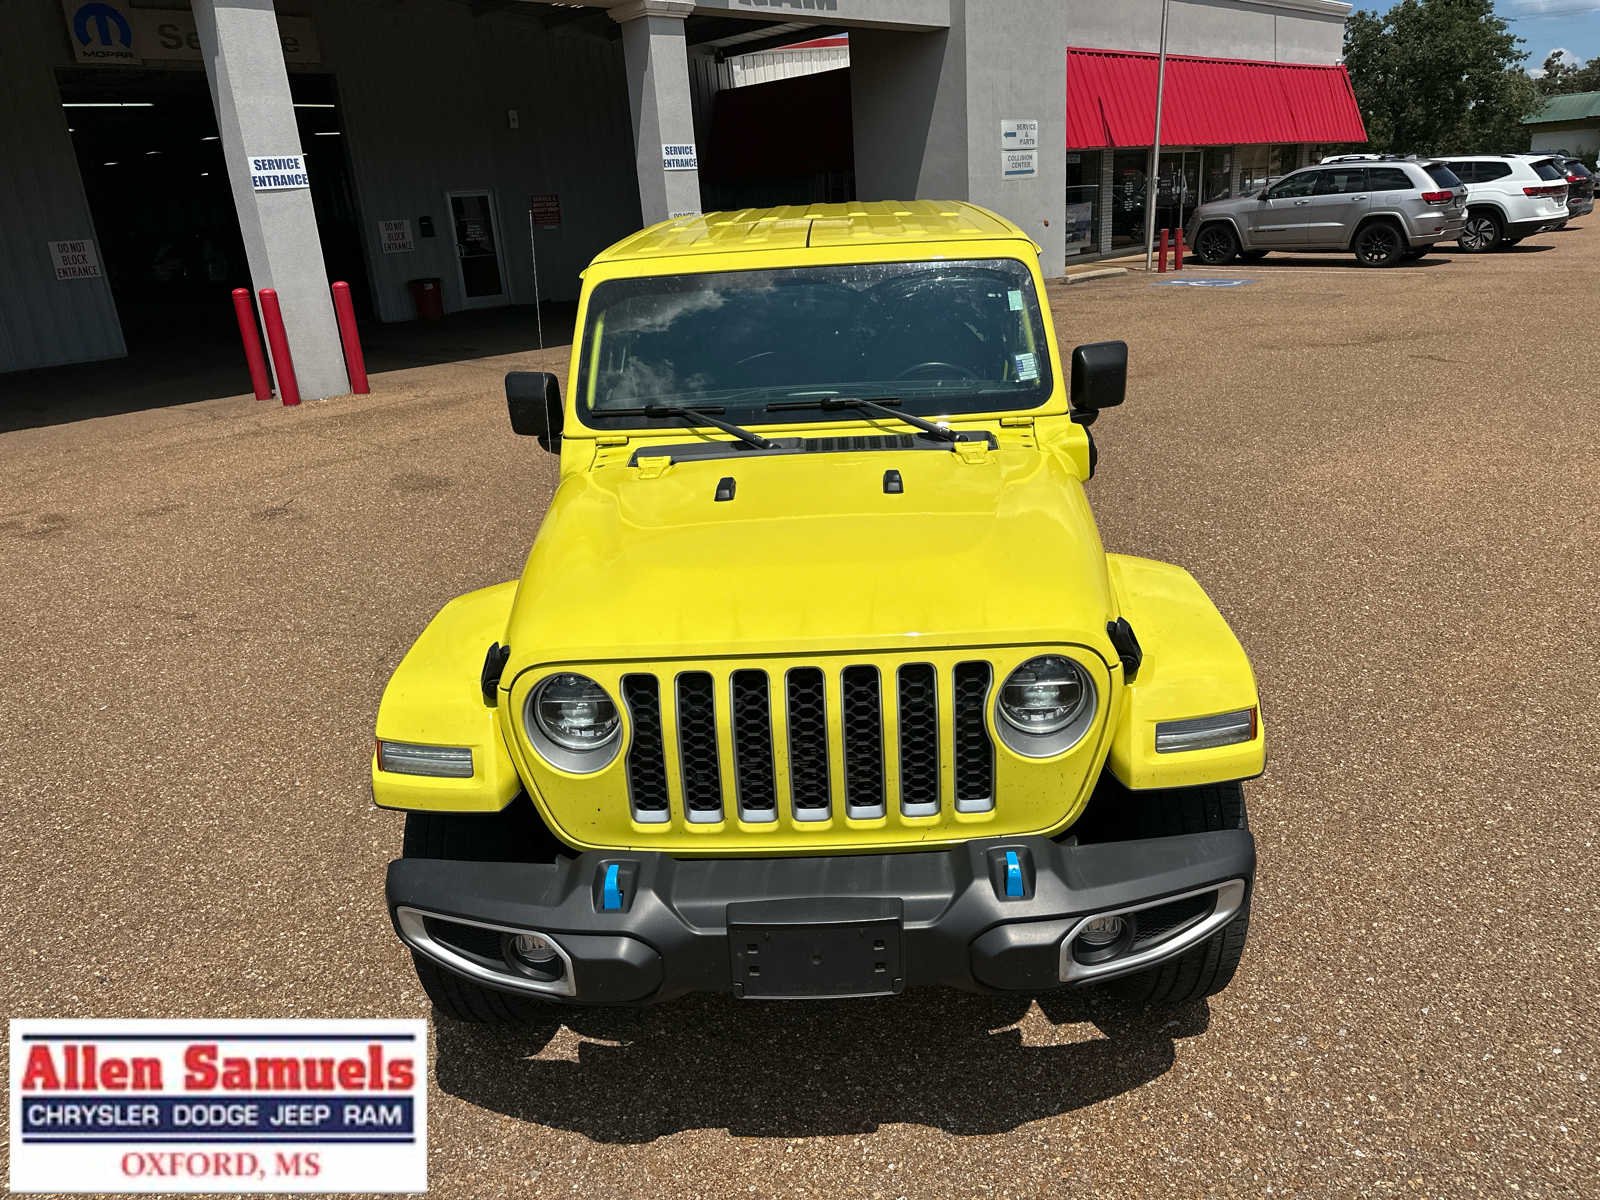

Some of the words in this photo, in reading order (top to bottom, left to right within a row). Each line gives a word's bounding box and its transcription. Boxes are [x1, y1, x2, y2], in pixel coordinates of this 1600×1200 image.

[82, 50, 133, 59] MOPAR
[665, 146, 693, 156] SERVICE
[254, 158, 301, 171] SERVICE
[663, 159, 697, 168] ENTRANCE
[251, 174, 309, 187] ENTRANCE
[57, 243, 69, 253] DO
[69, 242, 86, 252] NOT
[61, 254, 88, 265] BLOCK
[57, 265, 97, 278] ENTRANCE
